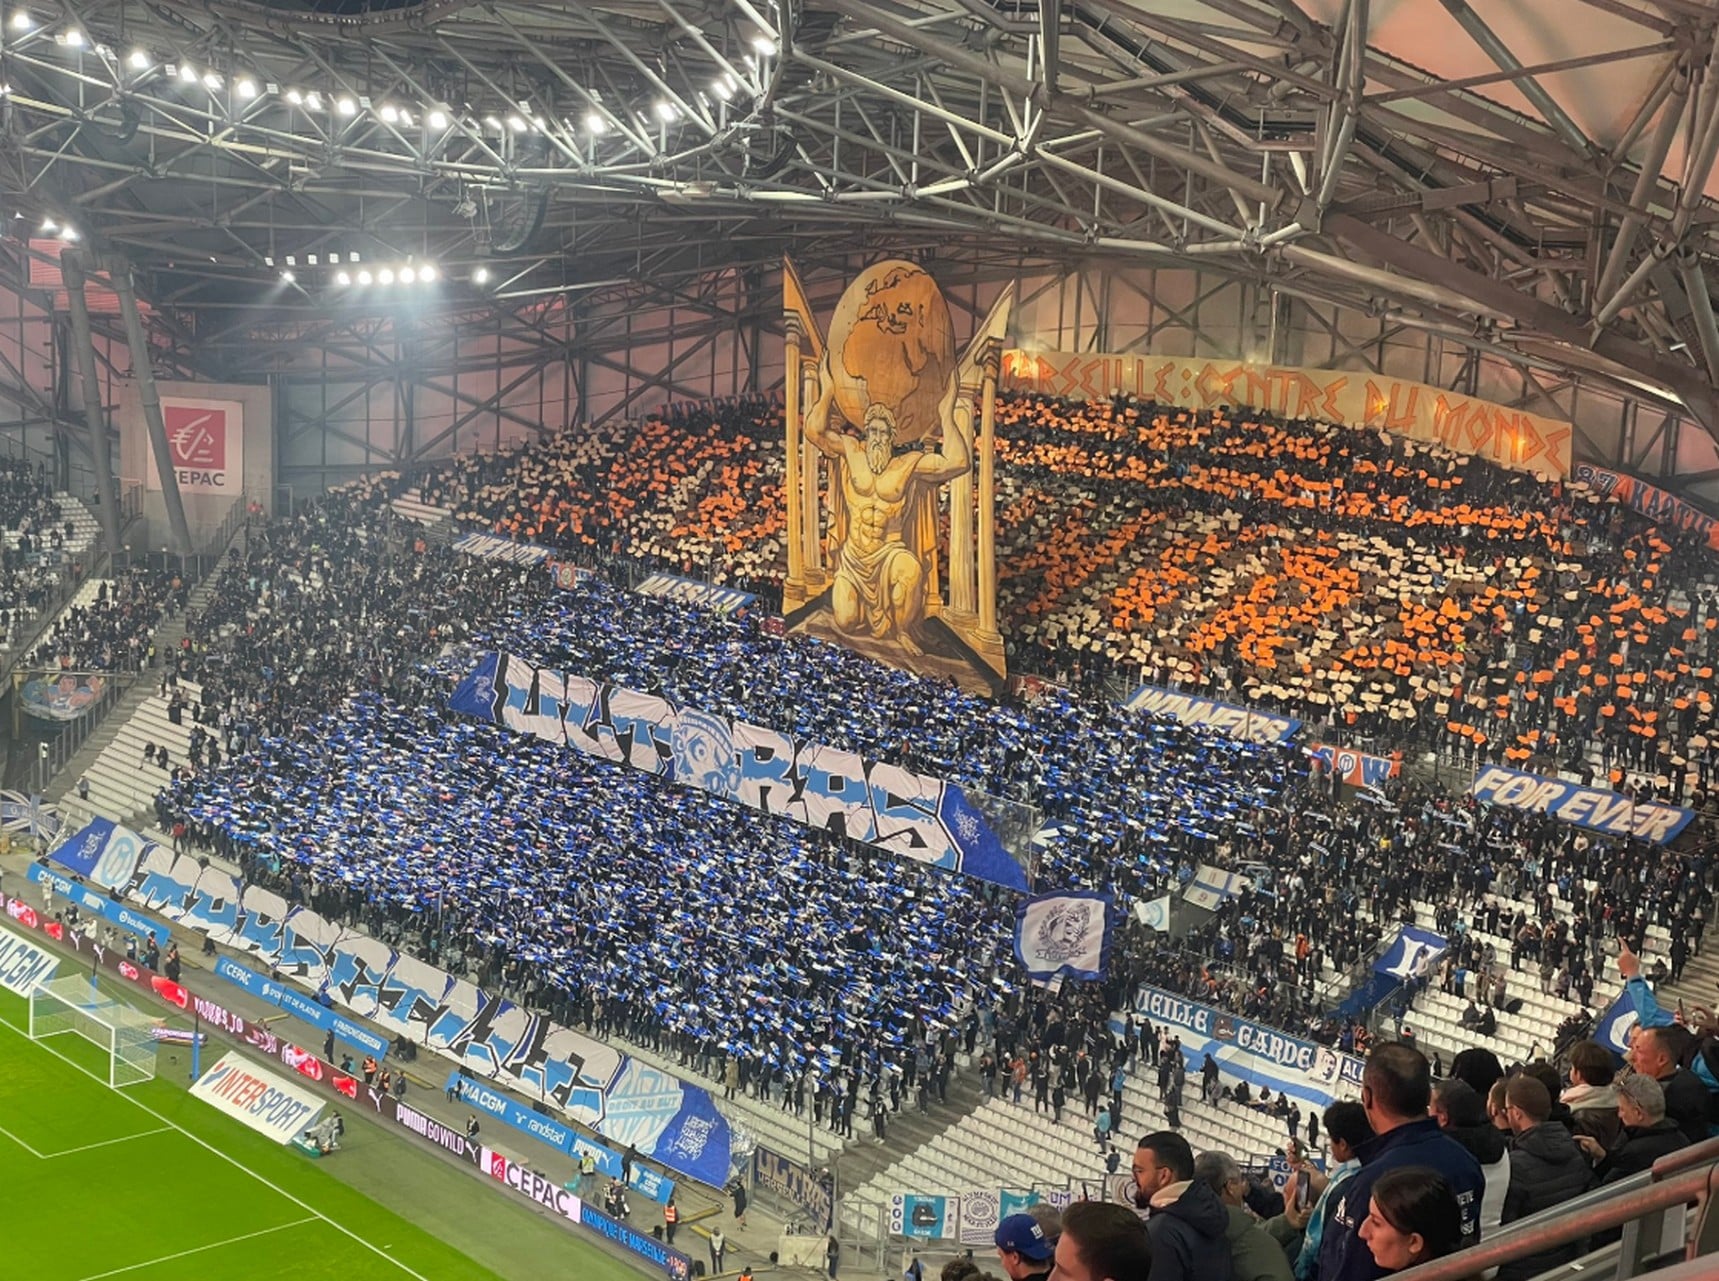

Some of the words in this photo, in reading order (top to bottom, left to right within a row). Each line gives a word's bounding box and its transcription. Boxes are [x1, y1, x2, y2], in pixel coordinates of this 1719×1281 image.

[1364, 380, 1418, 433] DU
[1432, 394, 1571, 475] MONDE
[177, 470, 225, 487] EPAC
[1127, 688, 1291, 744] WINNERS
[1468, 767, 1566, 813] FOR
[1557, 789, 1683, 842] EVER
[226, 963, 252, 986] CEPAC
[1237, 1024, 1314, 1069] GARDE
[211, 1066, 311, 1132] INTERSPORT
[396, 1102, 428, 1137] PUMA
[479, 1091, 507, 1116] CGM
[528, 1119, 566, 1145] randstad
[506, 1162, 570, 1217] CEPAC
